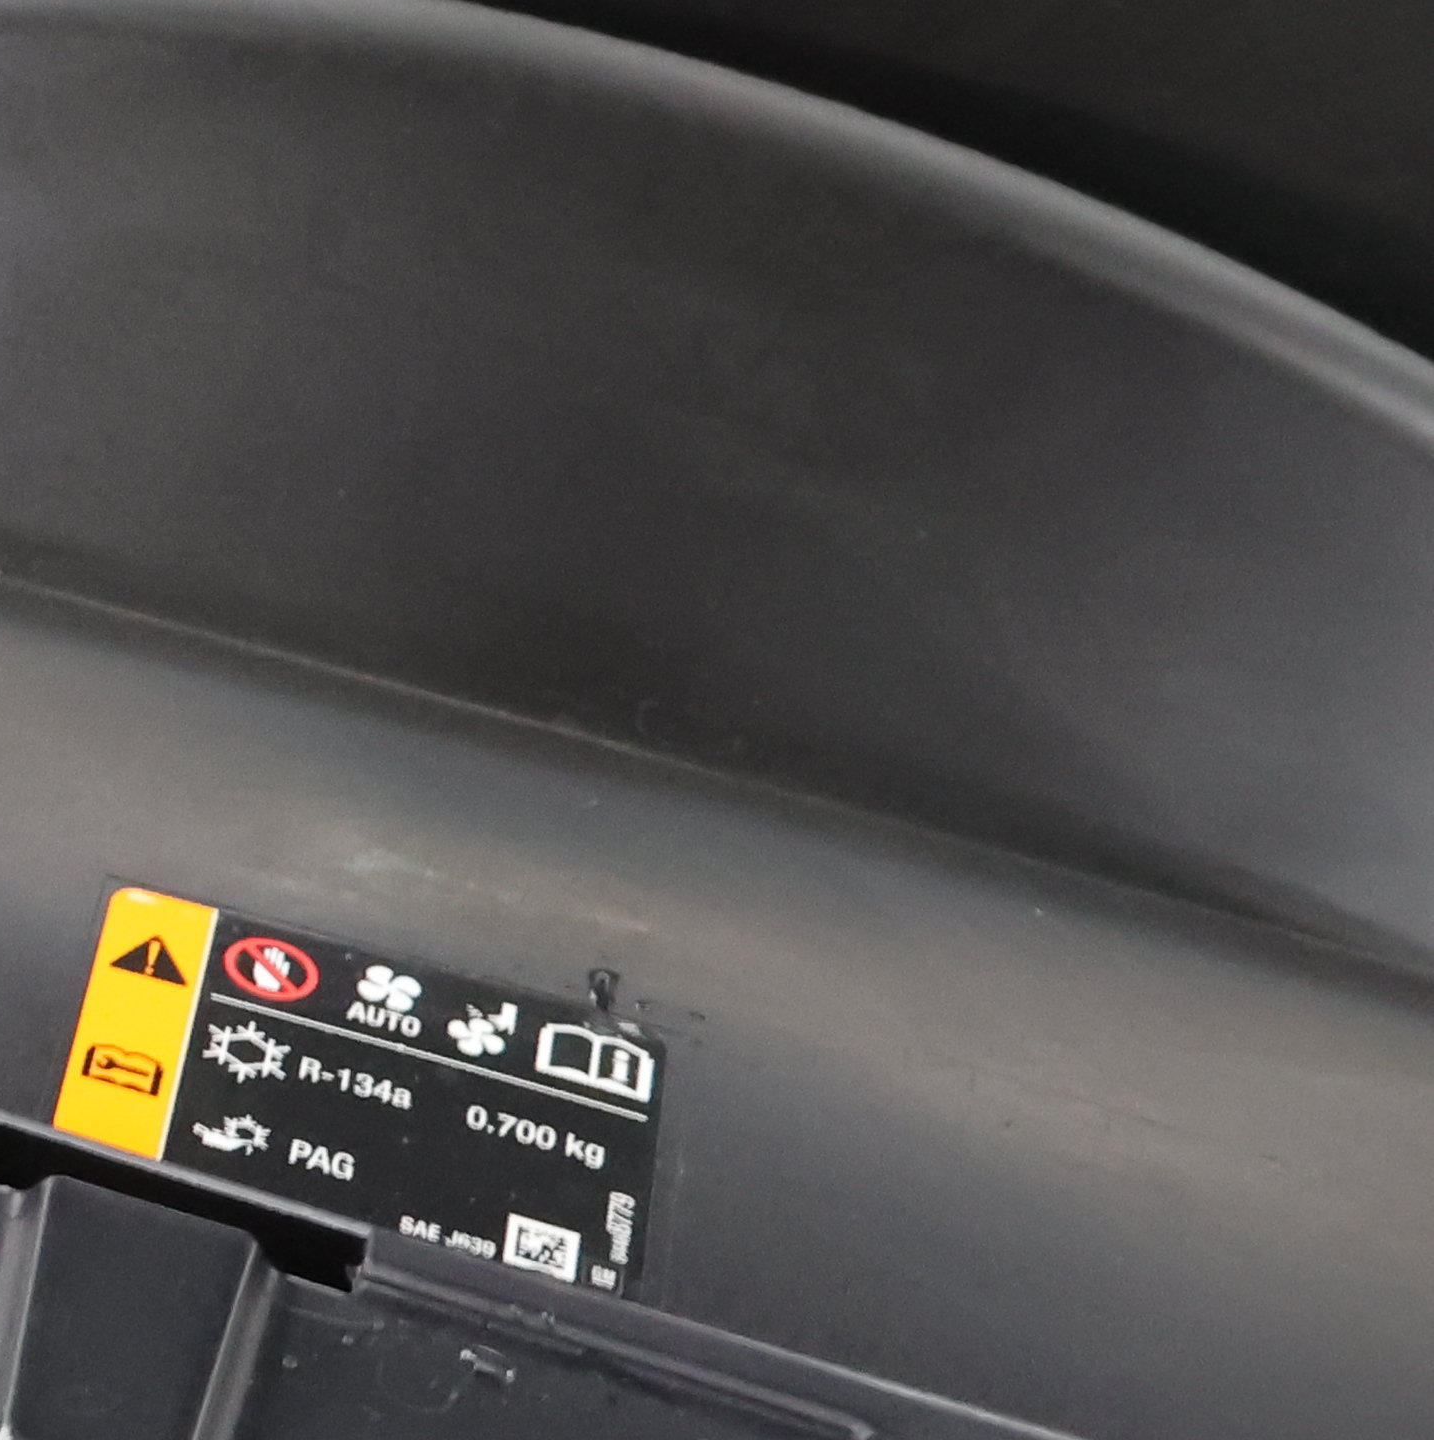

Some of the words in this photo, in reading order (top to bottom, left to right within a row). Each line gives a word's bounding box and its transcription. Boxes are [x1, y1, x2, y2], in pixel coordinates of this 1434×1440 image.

[347, 1001, 422, 1038] AUTO
[299, 1056, 412, 1110] R-134a
[467, 1106, 557, 1151] 0.700
[565, 1132, 606, 1170] kg
[289, 1139, 355, 1181] PAG
[400, 1215, 442, 1243] SAE
